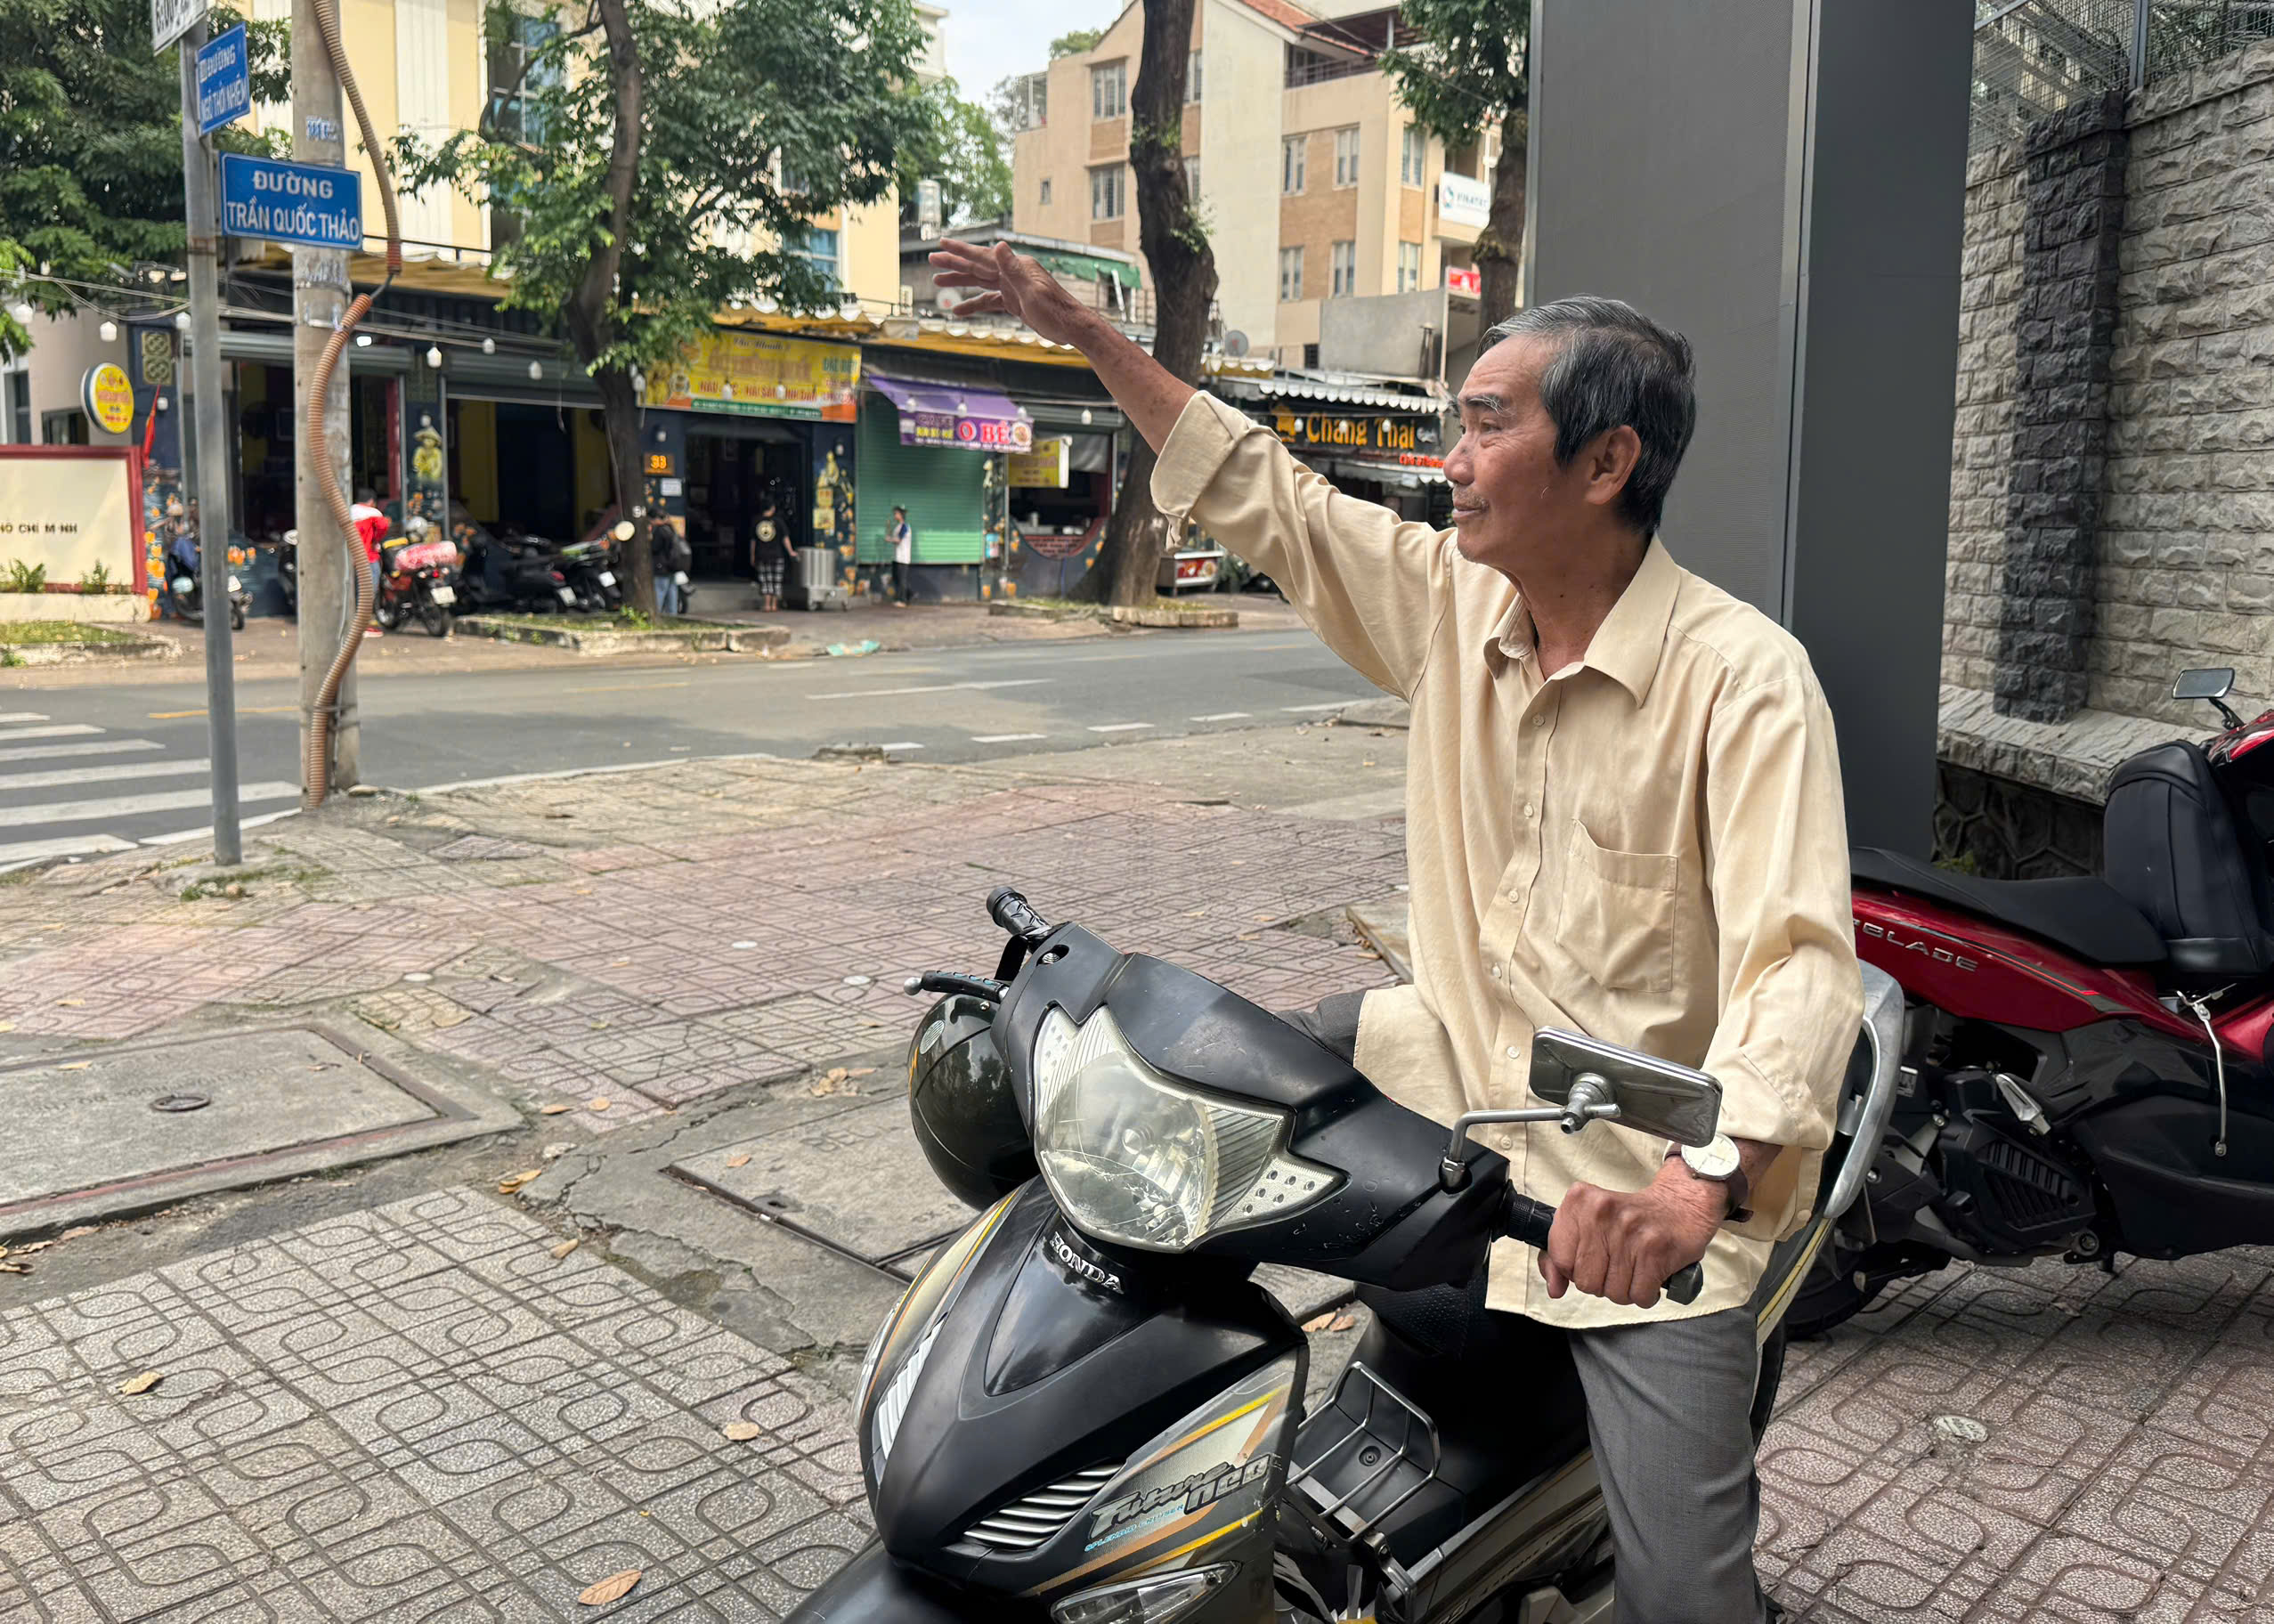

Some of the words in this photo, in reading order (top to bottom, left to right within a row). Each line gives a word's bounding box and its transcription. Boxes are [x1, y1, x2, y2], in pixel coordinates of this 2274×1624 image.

[253, 170, 334, 199] ĐƯỜNG
[227, 195, 270, 231] TRẦN
[273, 202, 317, 236] QUỐC
[318, 207, 360, 242] THẢO
[1306, 412, 1368, 445] Chang
[1374, 416, 1416, 450] Thai
[1049, 1231, 1124, 1295] HONDA
